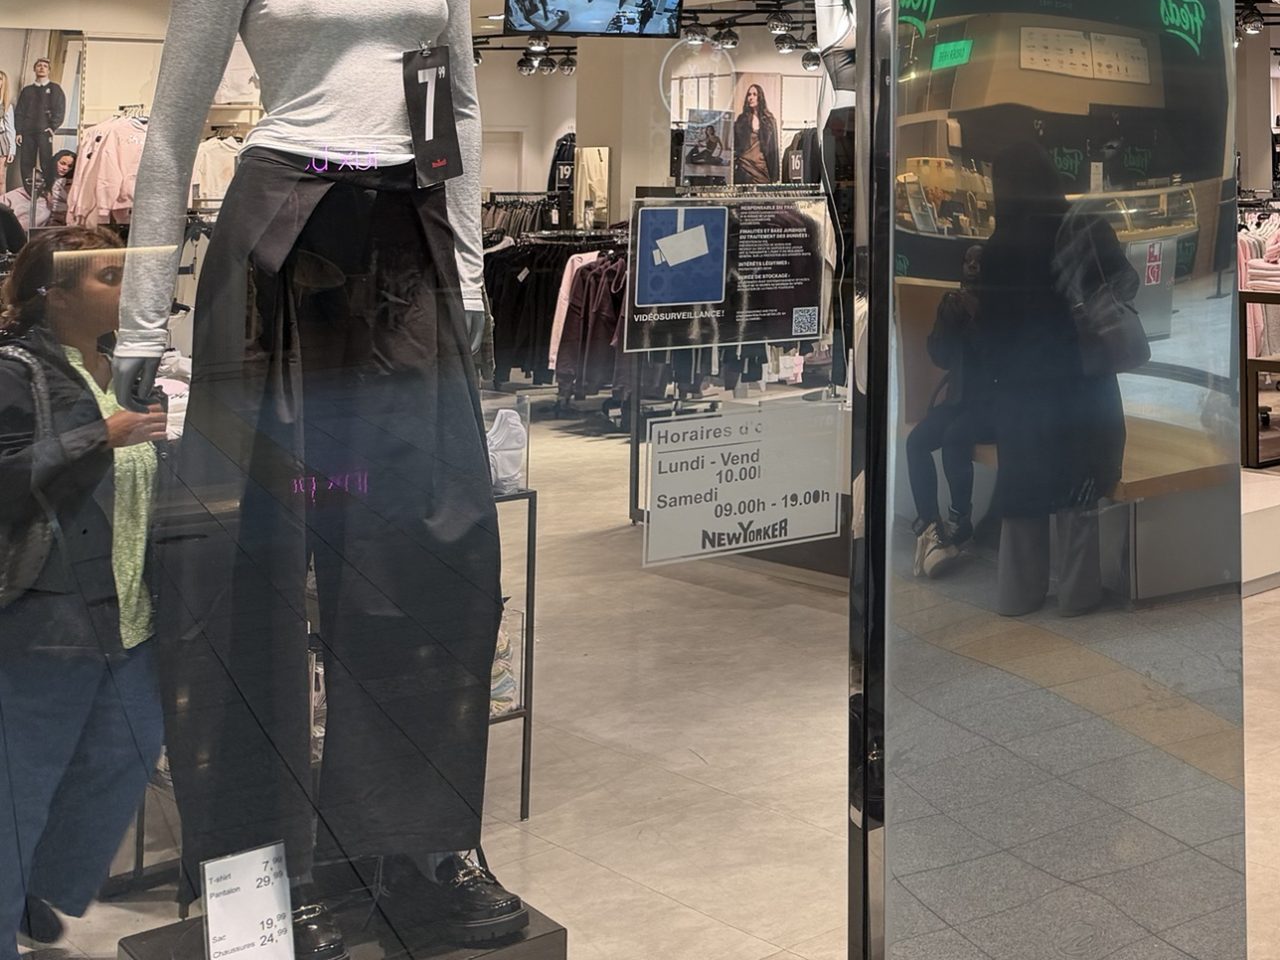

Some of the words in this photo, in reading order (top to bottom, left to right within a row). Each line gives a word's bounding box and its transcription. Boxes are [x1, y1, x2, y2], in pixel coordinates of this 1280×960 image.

[657, 424, 732, 445] Horaires
[658, 456, 705, 474] Lundi
[656, 487, 718, 509] Samedi
[714, 498, 766, 518] 09.00h
[781, 490, 830, 509] 19.00h
[209, 873, 232, 885] T-shirt
[209, 886, 241, 899] Pantalon
[212, 934, 226, 944] Sac
[213, 942, 255, 959] Chaussures
